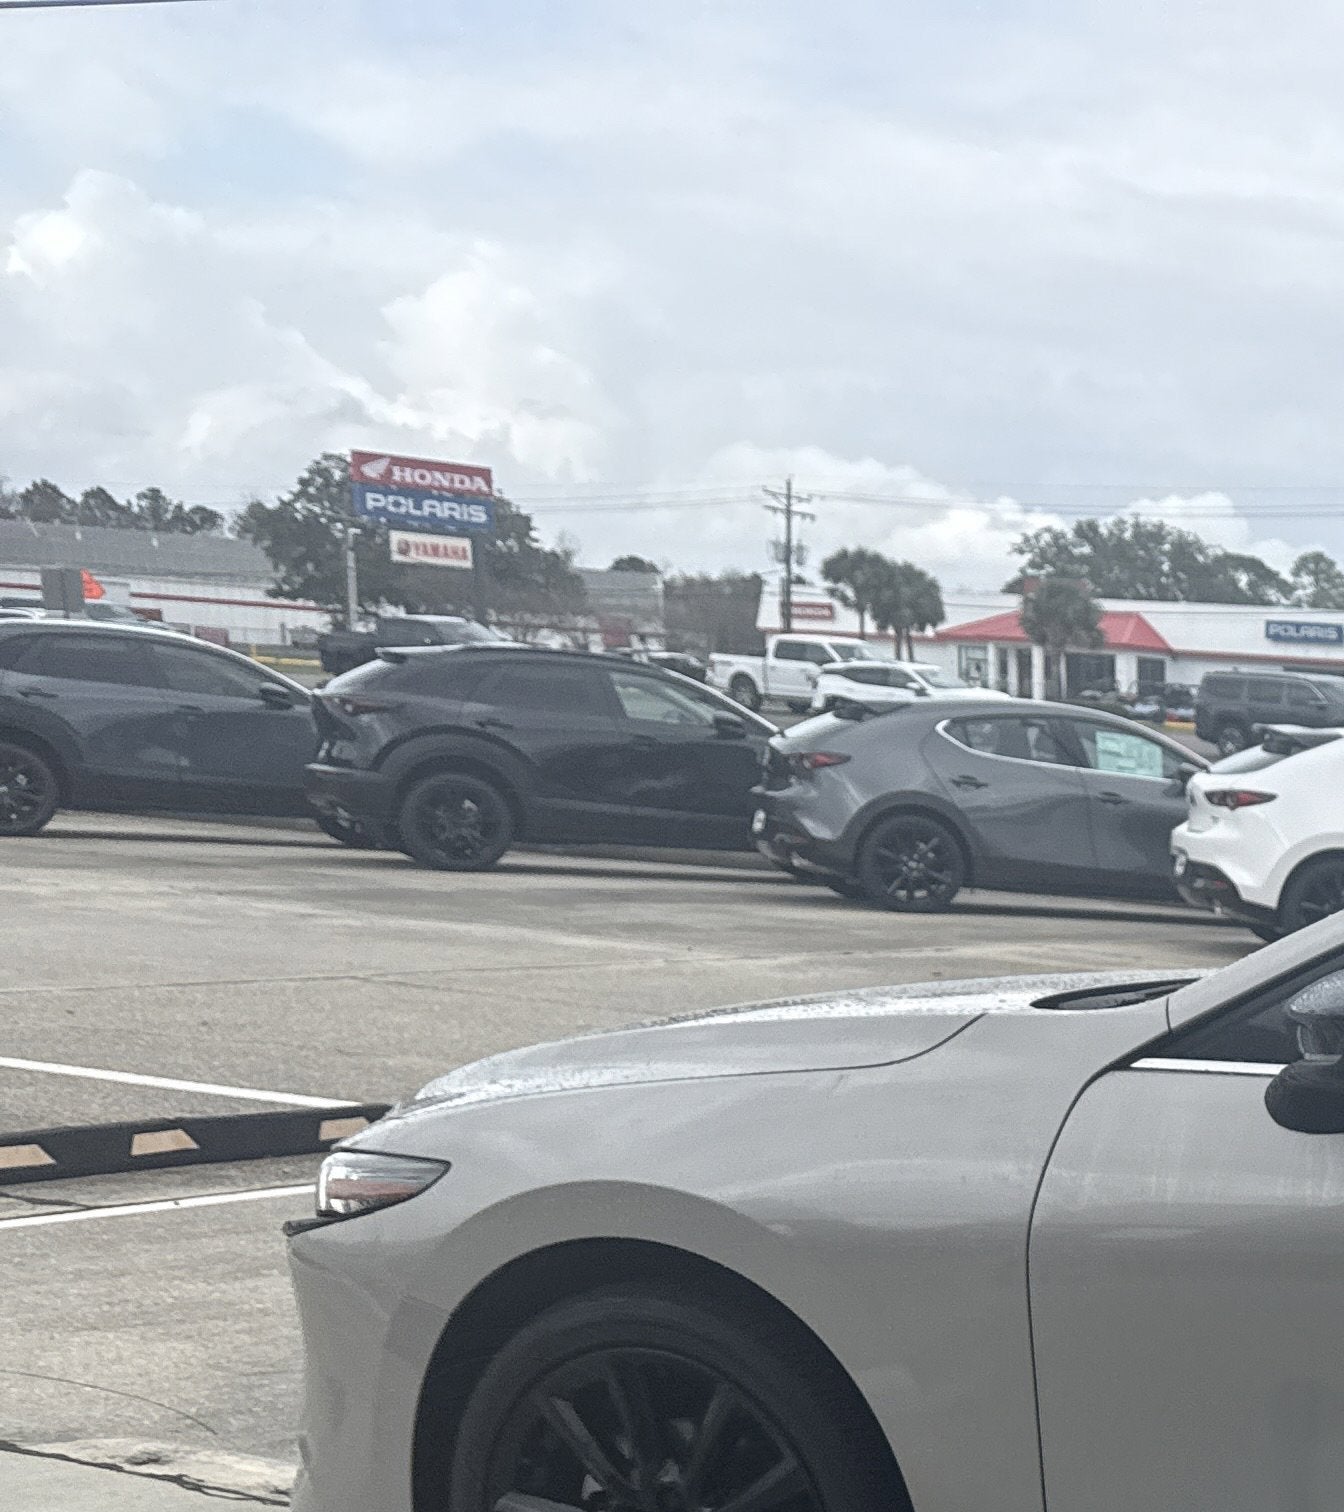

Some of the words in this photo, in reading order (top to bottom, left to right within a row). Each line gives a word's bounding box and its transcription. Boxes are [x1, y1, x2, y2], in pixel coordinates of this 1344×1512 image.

[391, 465, 490, 494] HONDA
[364, 491, 488, 524] POLARIS
[410, 540, 470, 561] YAMAHA
[1267, 623, 1339, 640] POLARIS
